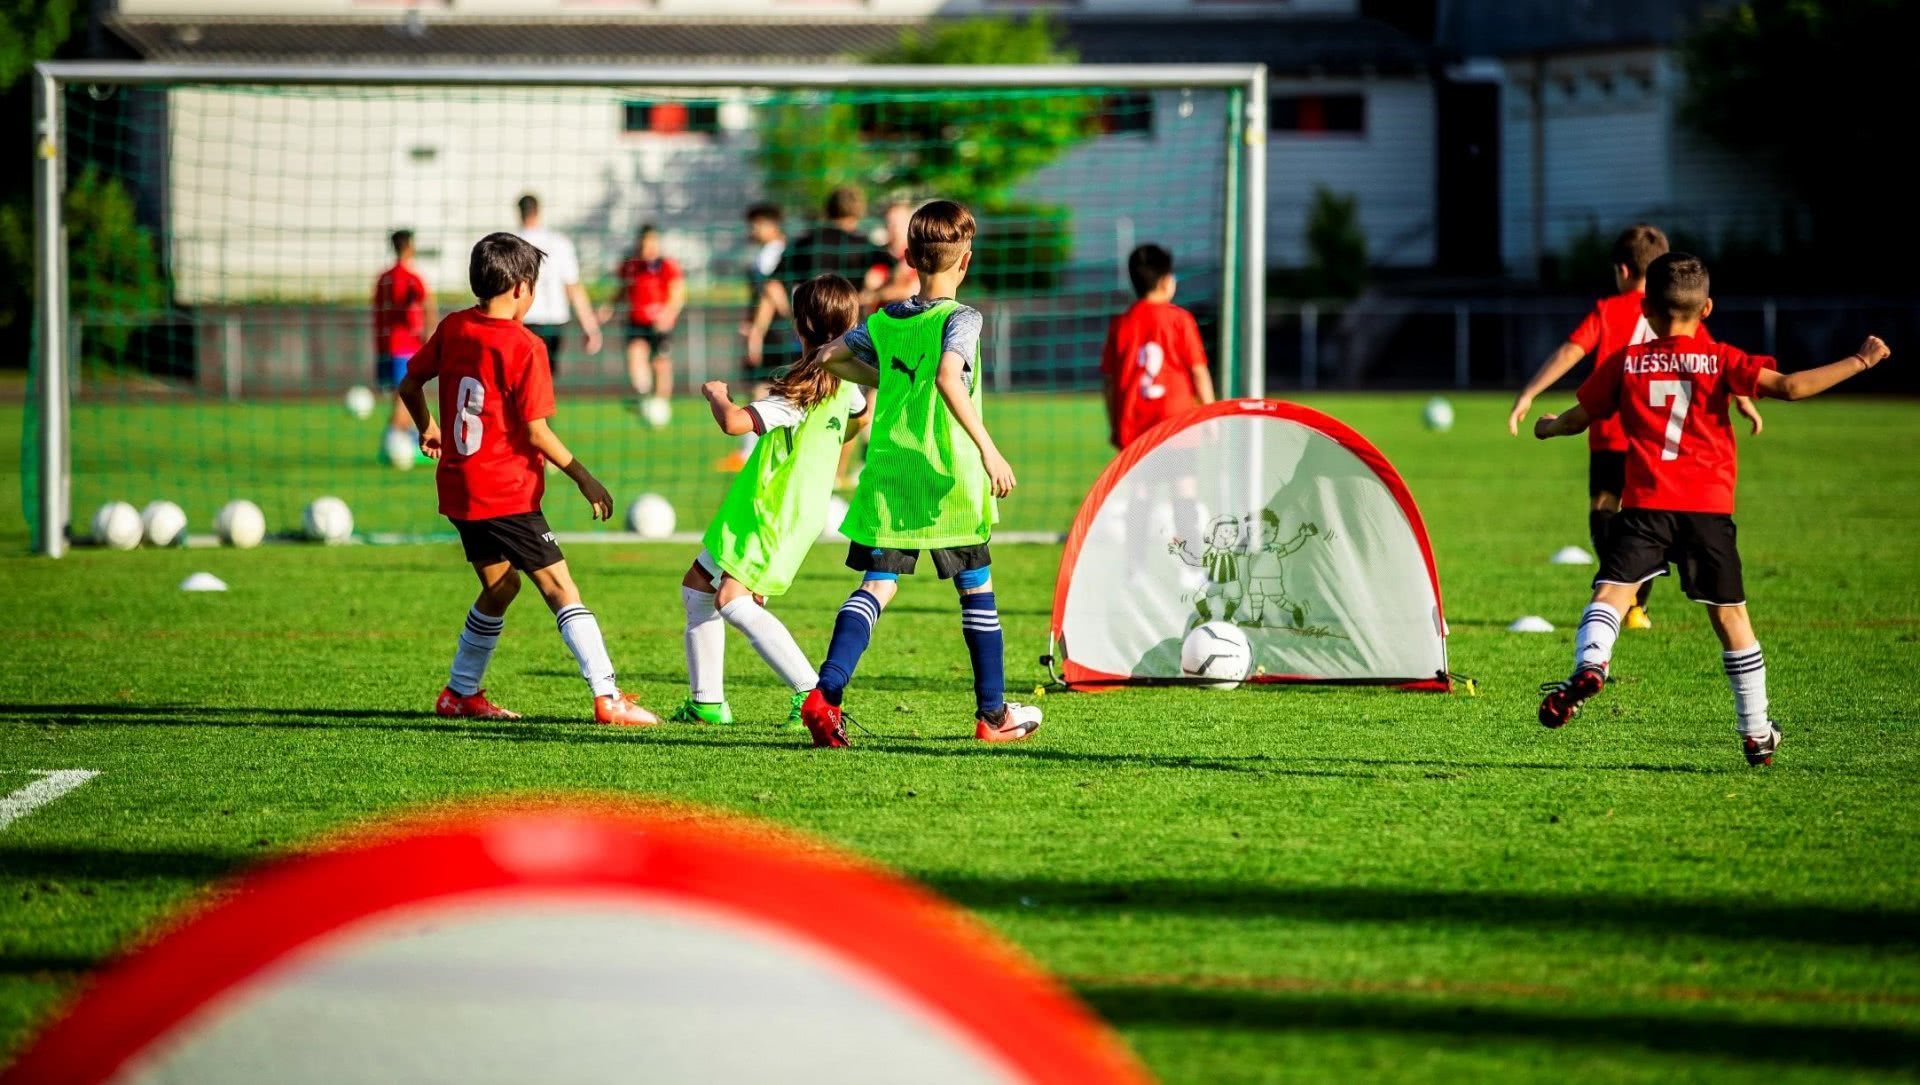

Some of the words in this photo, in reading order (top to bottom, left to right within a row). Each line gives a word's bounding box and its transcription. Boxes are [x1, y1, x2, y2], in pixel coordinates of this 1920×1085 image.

[1137, 341, 1166, 399] 2
[1624, 353, 1718, 374] ALESSANDRO
[454, 376, 485, 455] 8
[1649, 380, 1692, 461] 7
